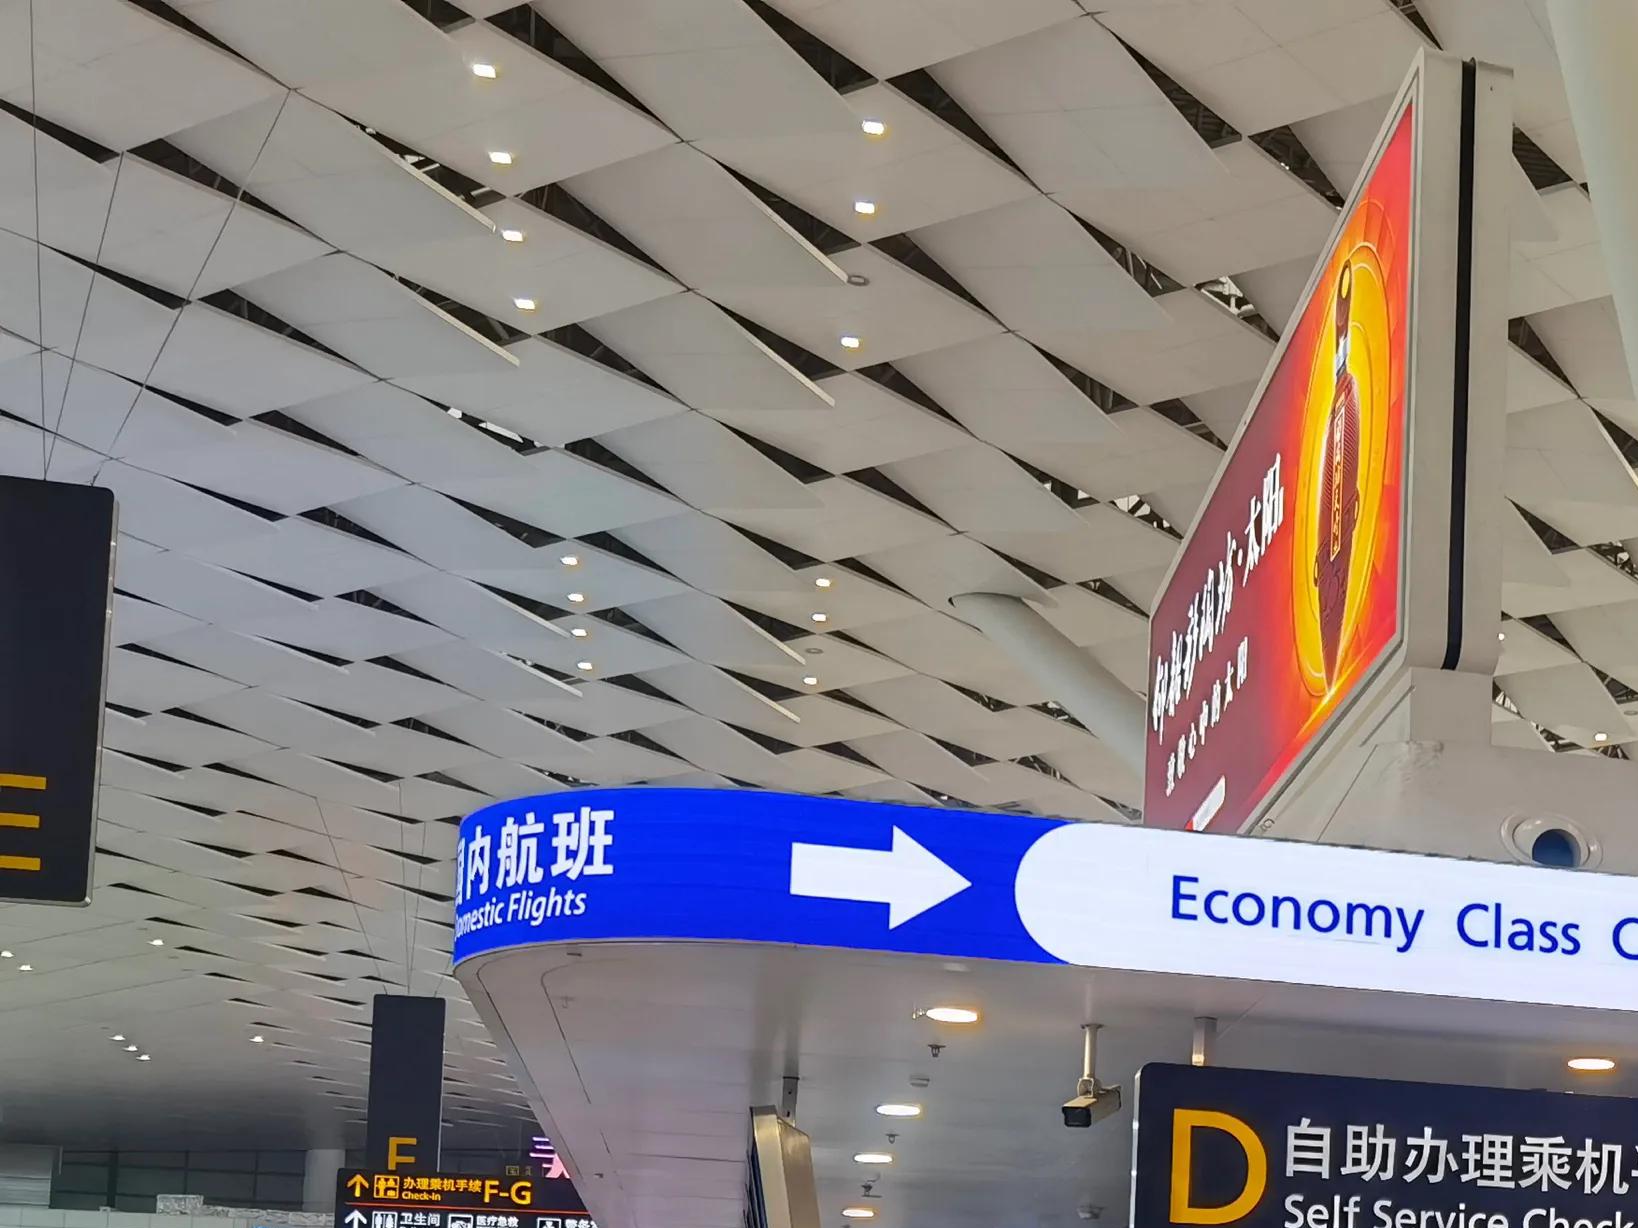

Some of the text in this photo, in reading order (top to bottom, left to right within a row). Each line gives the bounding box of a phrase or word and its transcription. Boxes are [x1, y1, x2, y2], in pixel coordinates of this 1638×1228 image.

[507, 887, 587, 926] Flights
[1171, 875, 1424, 953] Economy
[1456, 903, 1581, 956] Class
[387, 1136, 418, 1171] F
[1169, 1107, 1267, 1225] D
[402, 1191, 441, 1202] Check-in
[403, 1177, 532, 1205] 办理乘机手续 F-G
[400, 1213, 440, 1227] 卫生间
